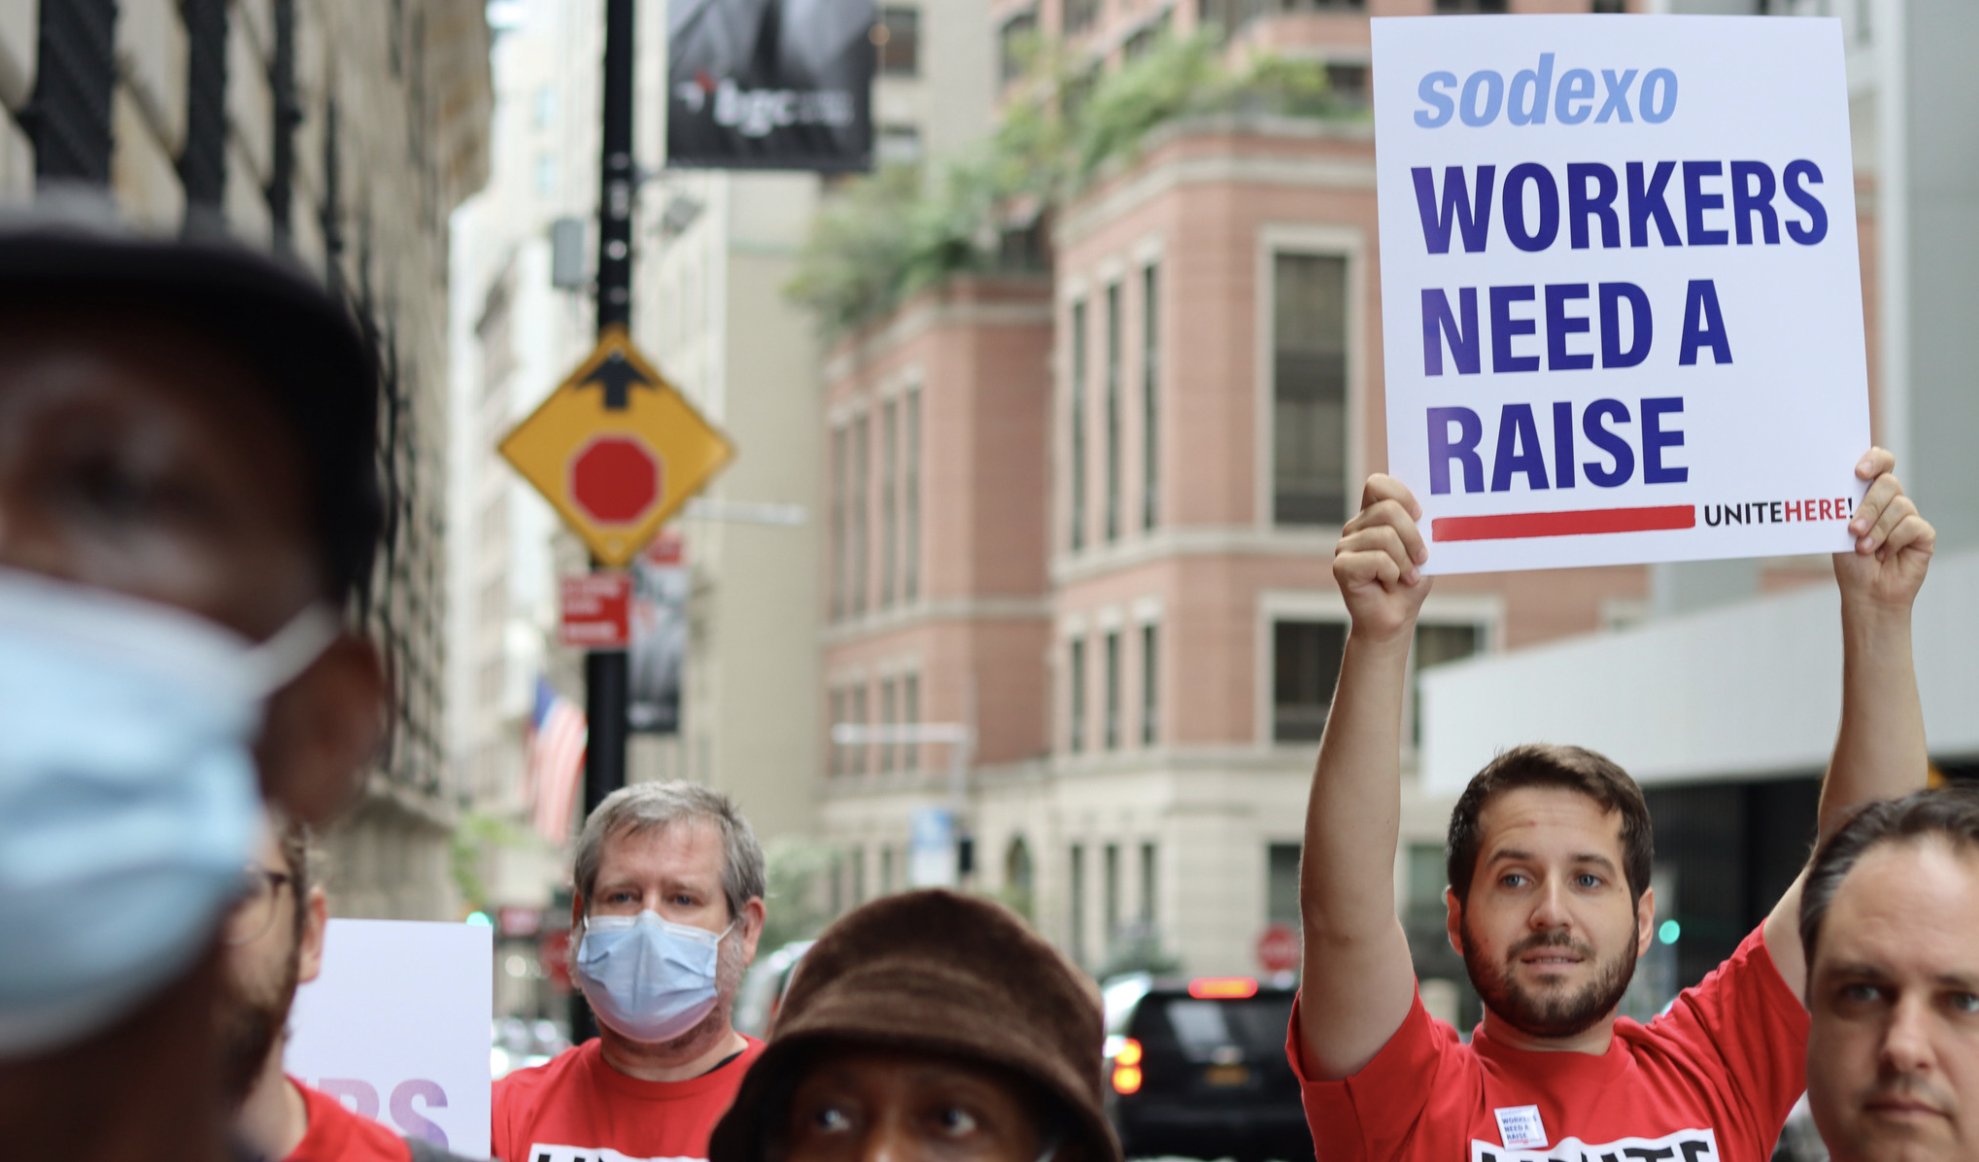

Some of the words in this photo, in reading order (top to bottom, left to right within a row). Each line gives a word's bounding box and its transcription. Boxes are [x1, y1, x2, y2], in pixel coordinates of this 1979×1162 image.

[1413, 52, 1678, 129] sodexo
[1410, 159, 1829, 255] WORKERS
[1420, 281, 1654, 377] NEED
[1678, 279, 1734, 367] A
[1426, 396, 1689, 495] RAISE
[1704, 497, 1854, 527] UNITEHERE!
